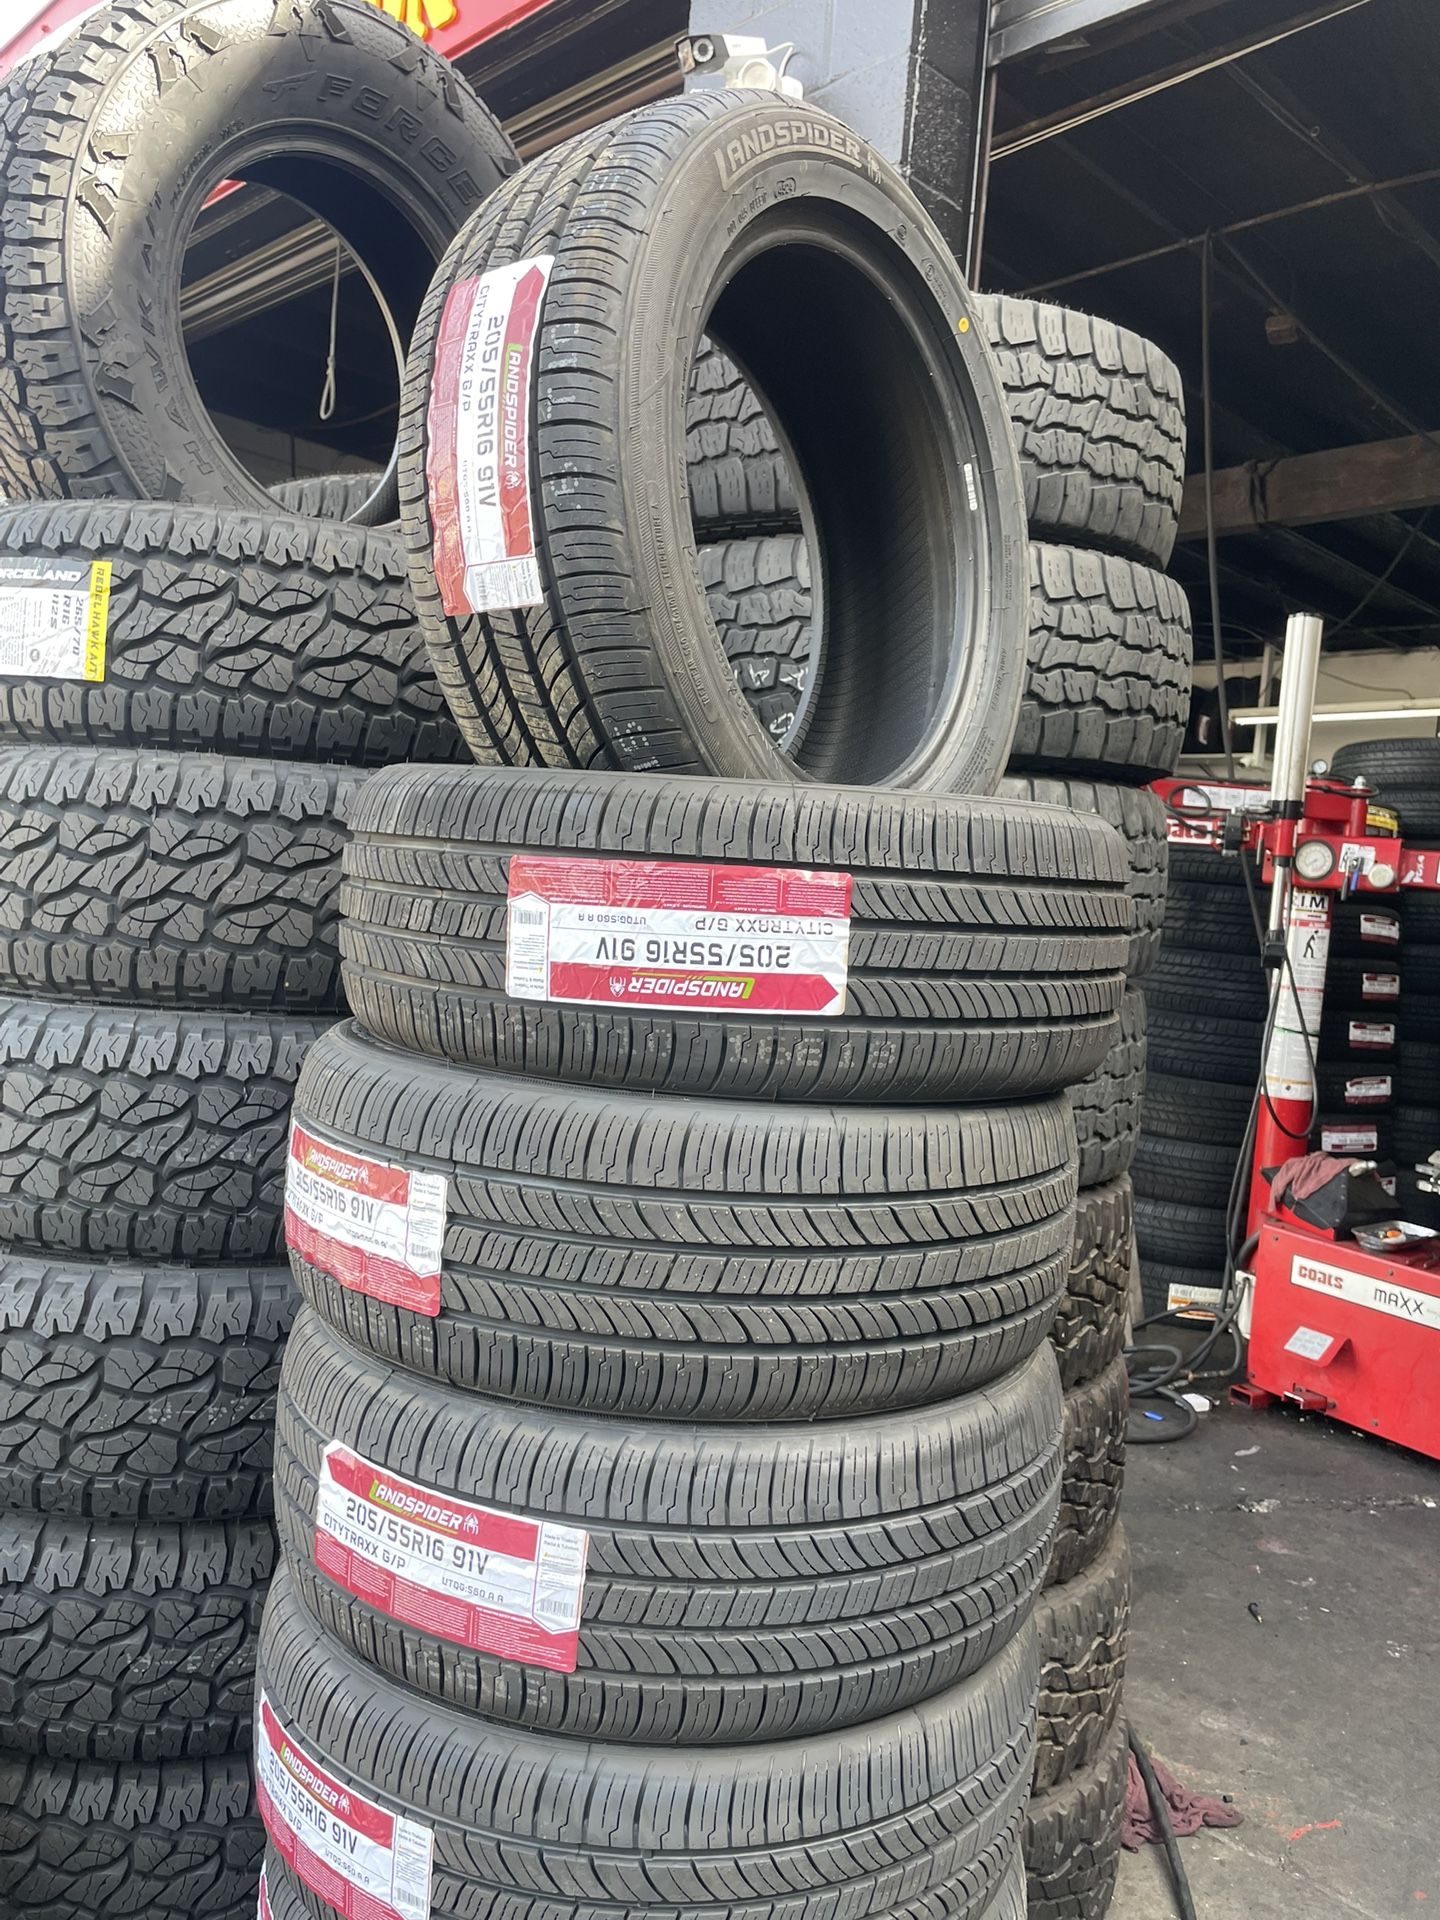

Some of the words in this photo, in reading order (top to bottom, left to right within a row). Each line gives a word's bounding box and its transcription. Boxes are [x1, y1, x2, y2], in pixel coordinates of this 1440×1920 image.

[714, 121, 862, 191] LANDSPIDER
[464, 285, 488, 372] CITYTRAXX
[461, 380, 471, 411] G/P
[478, 315, 504, 454] 205/55R16
[502, 343, 522, 468] LANDSPIDER
[477, 465, 497, 506] 91V
[95, 568, 105, 608] REBEL
[51, 594, 59, 629] 112S
[62, 595, 71, 625] R16
[73, 598, 84, 656] 265/70
[91, 612, 100, 649] HAWK
[88, 653, 97, 677] A/T
[578, 913, 584, 921] A
[587, 914, 593, 922] A
[695, 917, 727, 931] G/P
[736, 917, 833, 936] CITYTRAXX
[596, 937, 635, 961] 91V
[647, 940, 790, 968] 205/55R16
[629, 973, 755, 999] LANDSPIDER
[350, 1199, 374, 1224] 91V
[368, 1479, 464, 1535] LANDSPIDER
[322, 1513, 381, 1558] CITYTRAXX
[381, 1550, 407, 1570] G/P
[343, 1497, 447, 1562] 205/55R16
[450, 1547, 489, 1576] 91V
[279, 1742, 341, 1808] LANDSPIDER
[268, 1751, 330, 1832] 205/55R16
[331, 1823, 360, 1855] 91V
